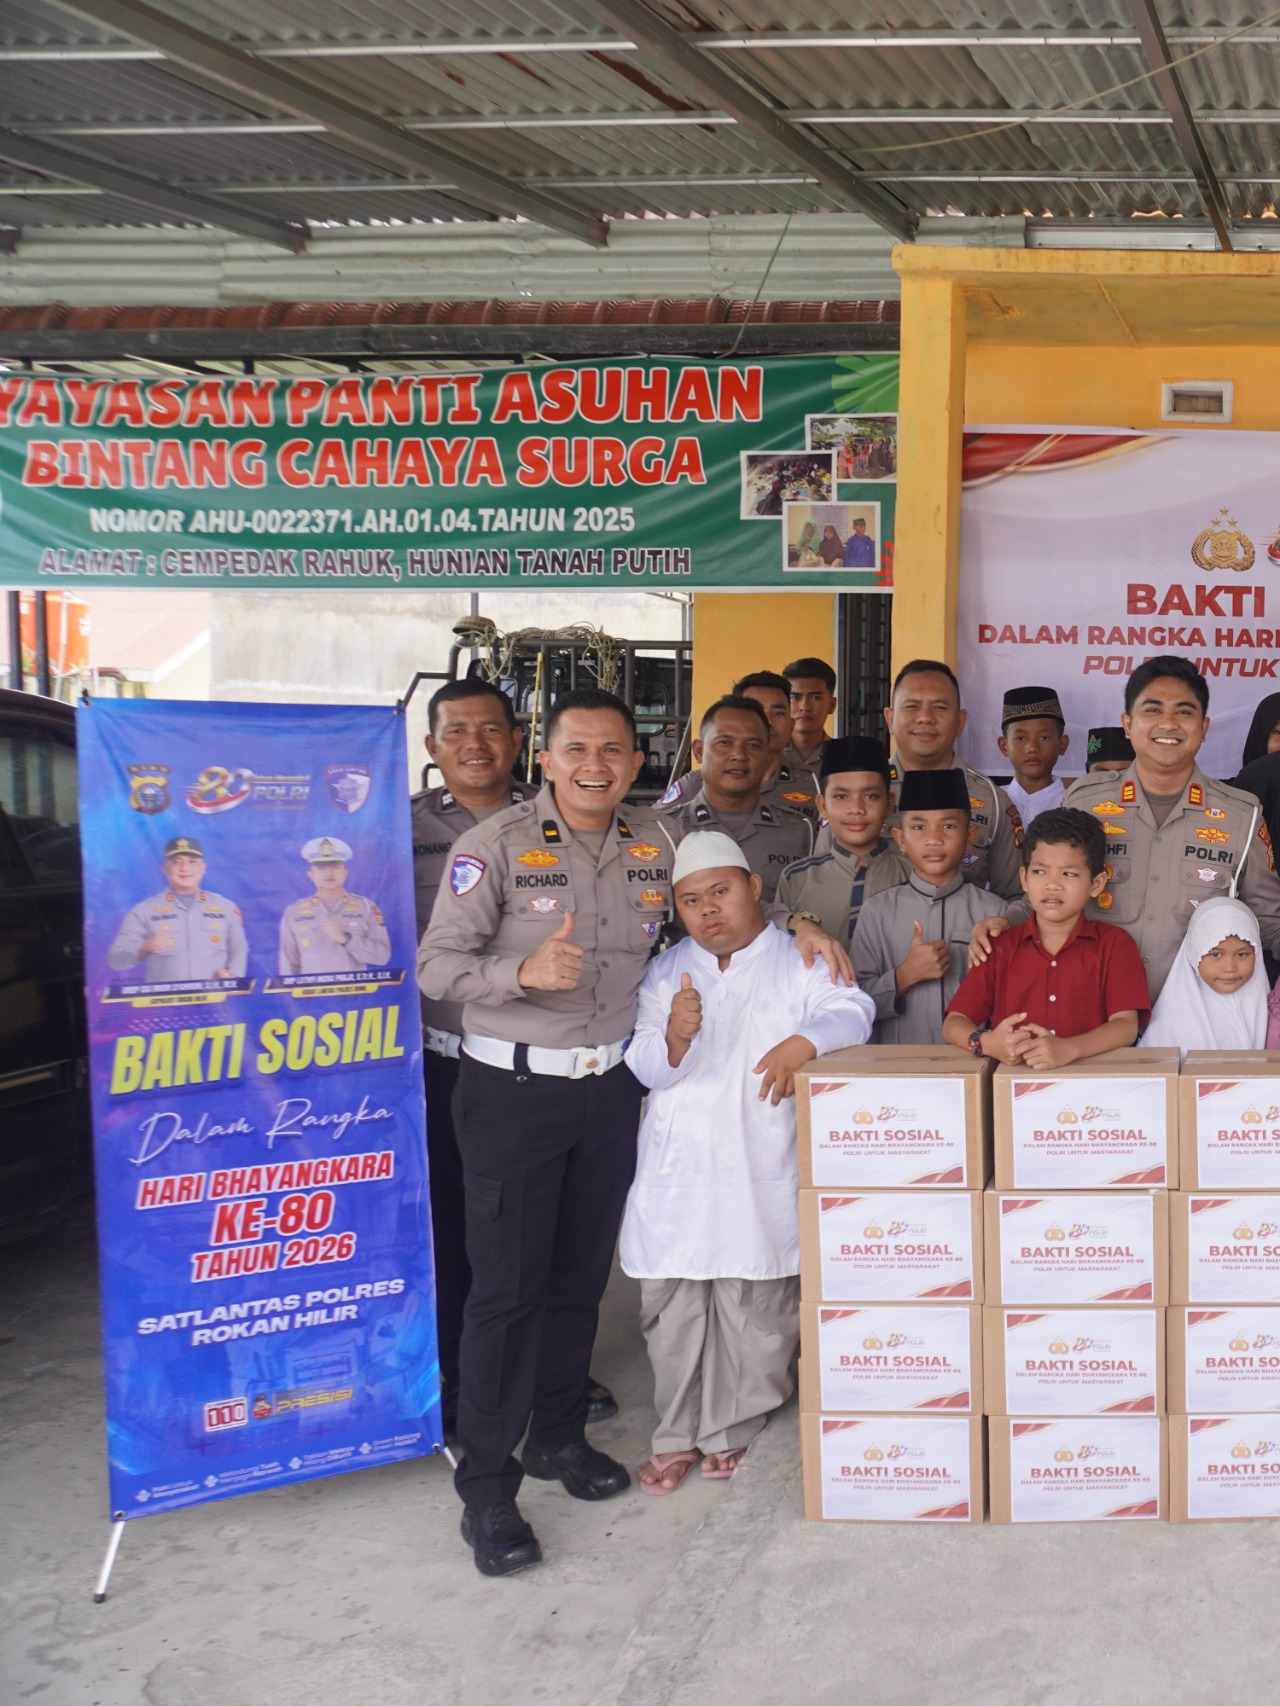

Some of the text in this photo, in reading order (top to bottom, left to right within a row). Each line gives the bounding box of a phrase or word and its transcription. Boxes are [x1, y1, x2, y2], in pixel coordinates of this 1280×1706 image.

[0, 366, 764, 428] YAYASAN PANTI ASUHAN
[22, 435, 707, 489] BINTANG CAHAYA SURGA
[89, 507, 636, 533] NOMOR AHU-0022371.AH.01.04.TAHUN 2025
[39, 548, 142, 575] ALAMAT
[161, 549, 298, 576] CEMPEDAK
[303, 548, 401, 581] RAHUK,
[408, 548, 511, 576] HUNIAN
[516, 548, 604, 576] TANAH
[611, 547, 692, 575] PUTIH
[1126, 583, 1265, 618] BAKTI
[978, 624, 1078, 645] DALAM
[1088, 625, 1207, 648] RANGKA
[1083, 655, 1155, 675] POL
[187, 766, 254, 814] 80
[253, 785, 310, 801] POLRI
[1184, 845, 1234, 864] POLRI
[515, 867, 669, 889] RICHARD POLRI
[110, 1005, 405, 1095] BAKTI SOSIAL
[128, 1094, 394, 1166] Dalam Rangka
[829, 1129, 946, 1142] BAKTI SOSIAL
[1032, 1129, 1149, 1142] BAKTI SOSIAL
[1217, 1129, 1268, 1141] BAKTI
[135, 1150, 395, 1210] HARI BHAYANGKARA
[209, 1190, 336, 1247] KE-80
[190, 1232, 357, 1283] TAHUN 2026
[840, 1244, 955, 1256] BAKTI SOSIAL
[1020, 1246, 1136, 1258] BAKTI SOSIAL
[1209, 1245, 1259, 1257] BAKTI
[137, 1278, 406, 1336] SATLANTAS POLRES
[191, 1305, 359, 1347] ROKAN HILIR
[839, 1355, 952, 1367] BAKTI SOSIAL
[1025, 1359, 1138, 1371] BAKTI SOSIAL
[1205, 1356, 1255, 1368] BAKTI
[208, 1404, 245, 1427] 110
[840, 1465, 951, 1478] BAKTI SOSIAL
[1207, 1463, 1256, 1475] BAKTI
